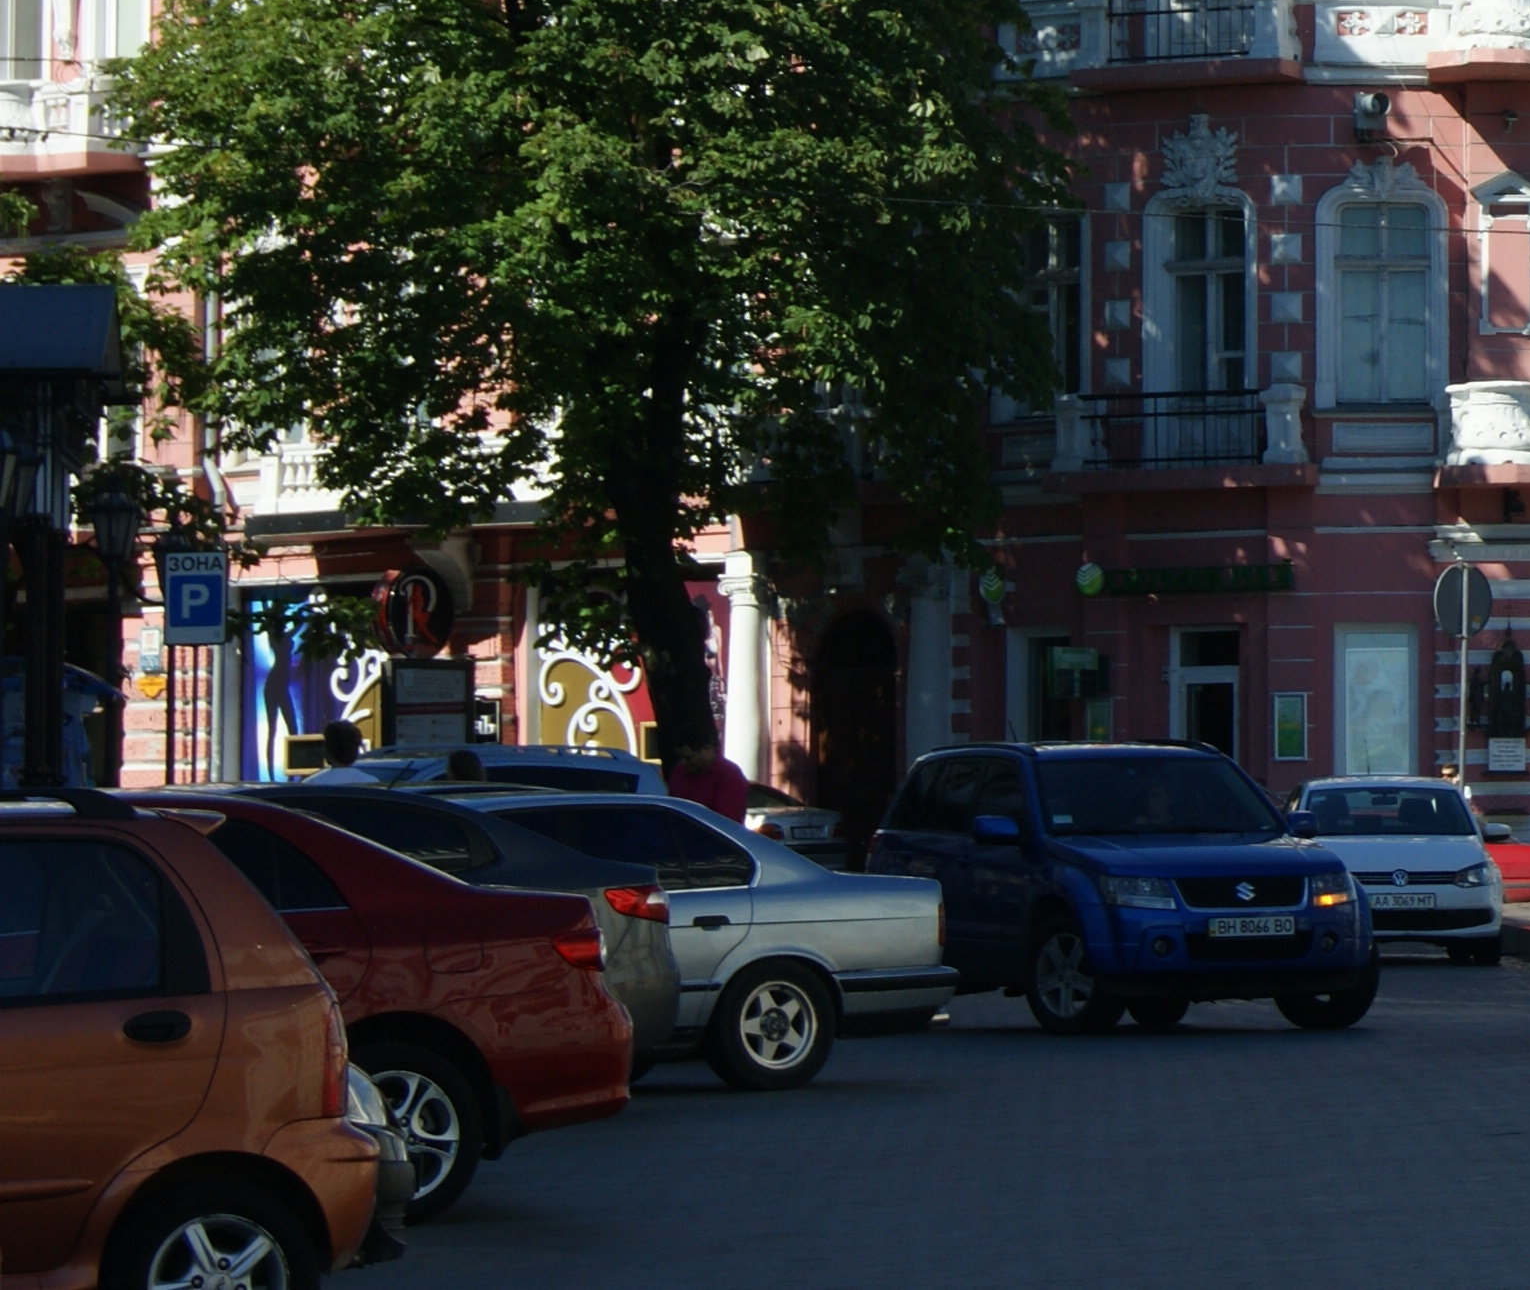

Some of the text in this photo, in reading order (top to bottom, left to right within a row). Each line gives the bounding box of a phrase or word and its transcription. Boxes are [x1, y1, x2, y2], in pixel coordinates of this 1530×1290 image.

[169, 556, 223, 572] ЗОНА
[181, 584, 210, 619] P
[1218, 917, 1293, 934] BH 8066 BO
